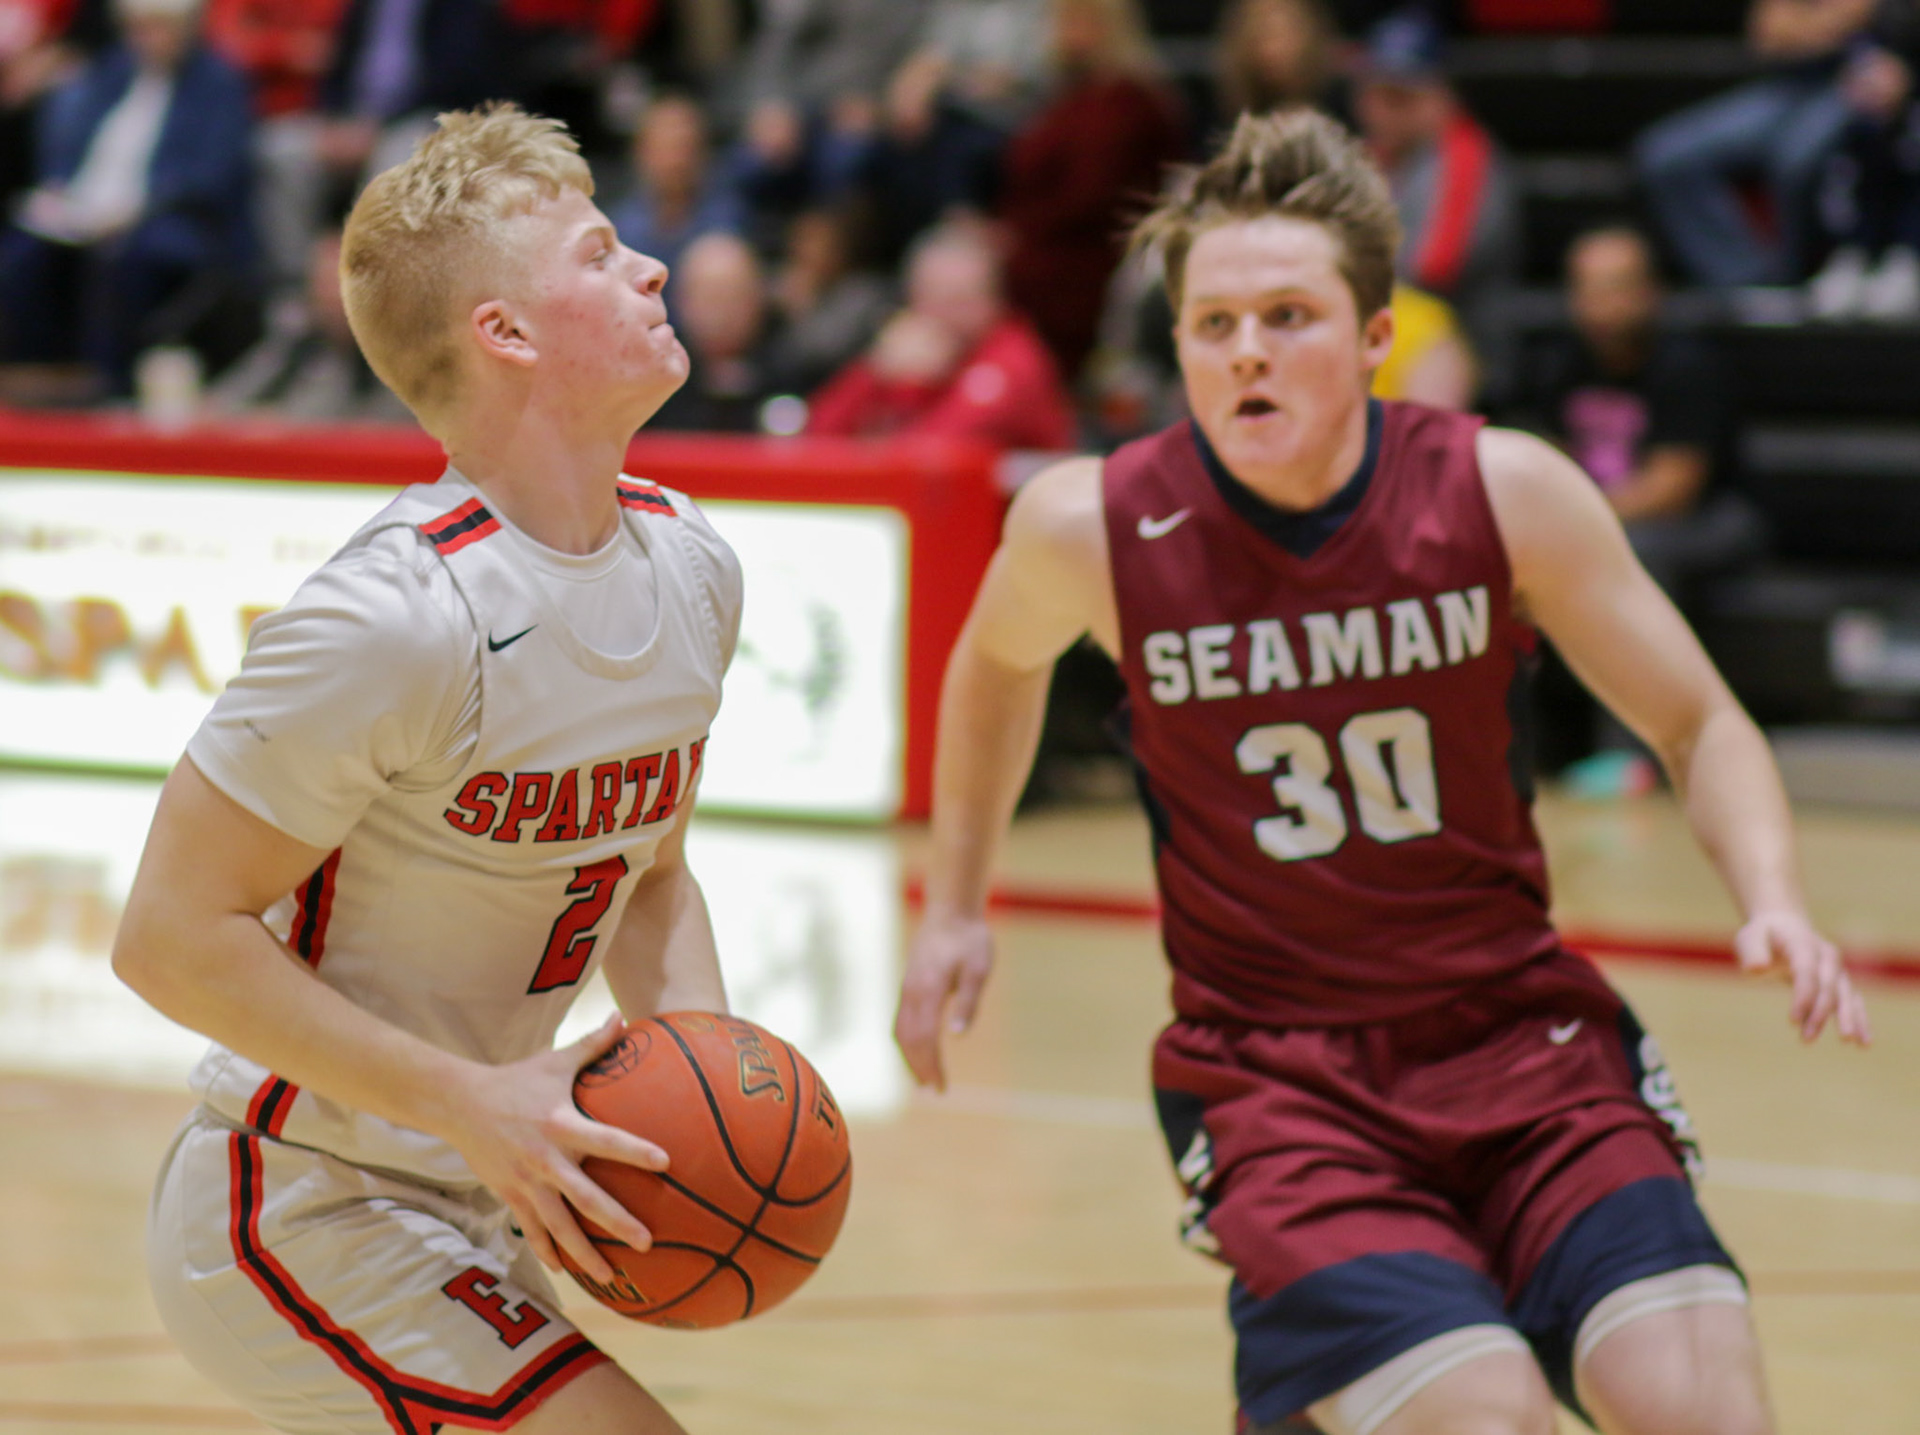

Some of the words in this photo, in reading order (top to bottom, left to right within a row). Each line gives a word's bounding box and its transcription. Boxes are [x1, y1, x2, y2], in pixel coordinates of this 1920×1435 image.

[1142, 584, 1490, 706] SEAMAN
[1234, 706, 1442, 862] 30
[526, 854, 629, 995] 2
[441, 1265, 551, 1351] E
